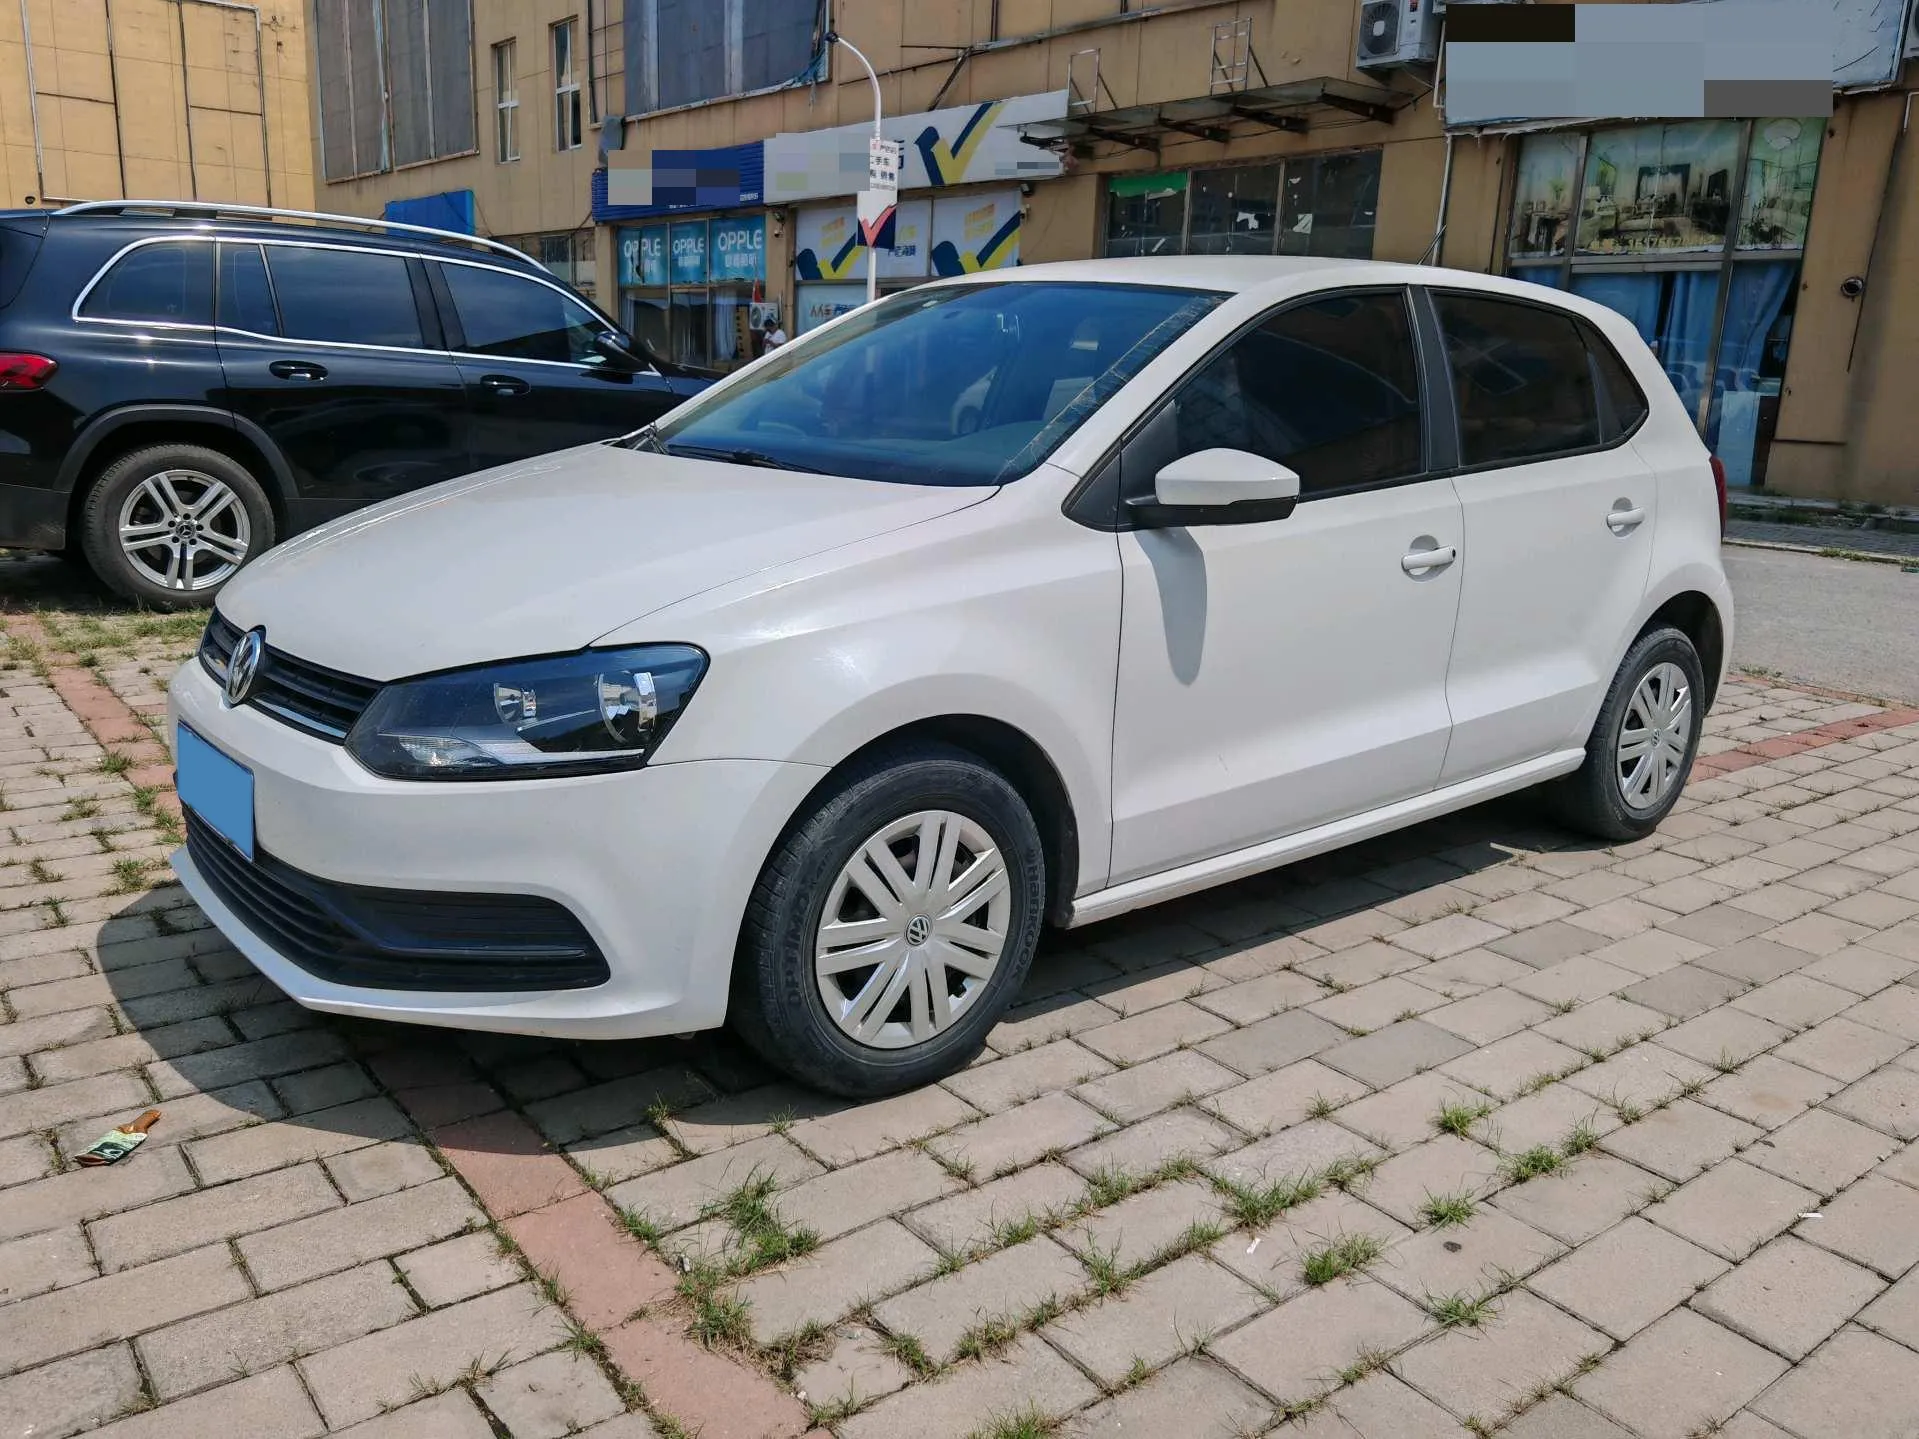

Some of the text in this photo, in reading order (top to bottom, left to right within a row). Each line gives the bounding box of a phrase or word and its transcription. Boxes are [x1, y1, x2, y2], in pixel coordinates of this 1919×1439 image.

[624, 238, 661, 258] OPPLE
[672, 237, 704, 254] OPPLE
[718, 229, 762, 251] OPPLE
